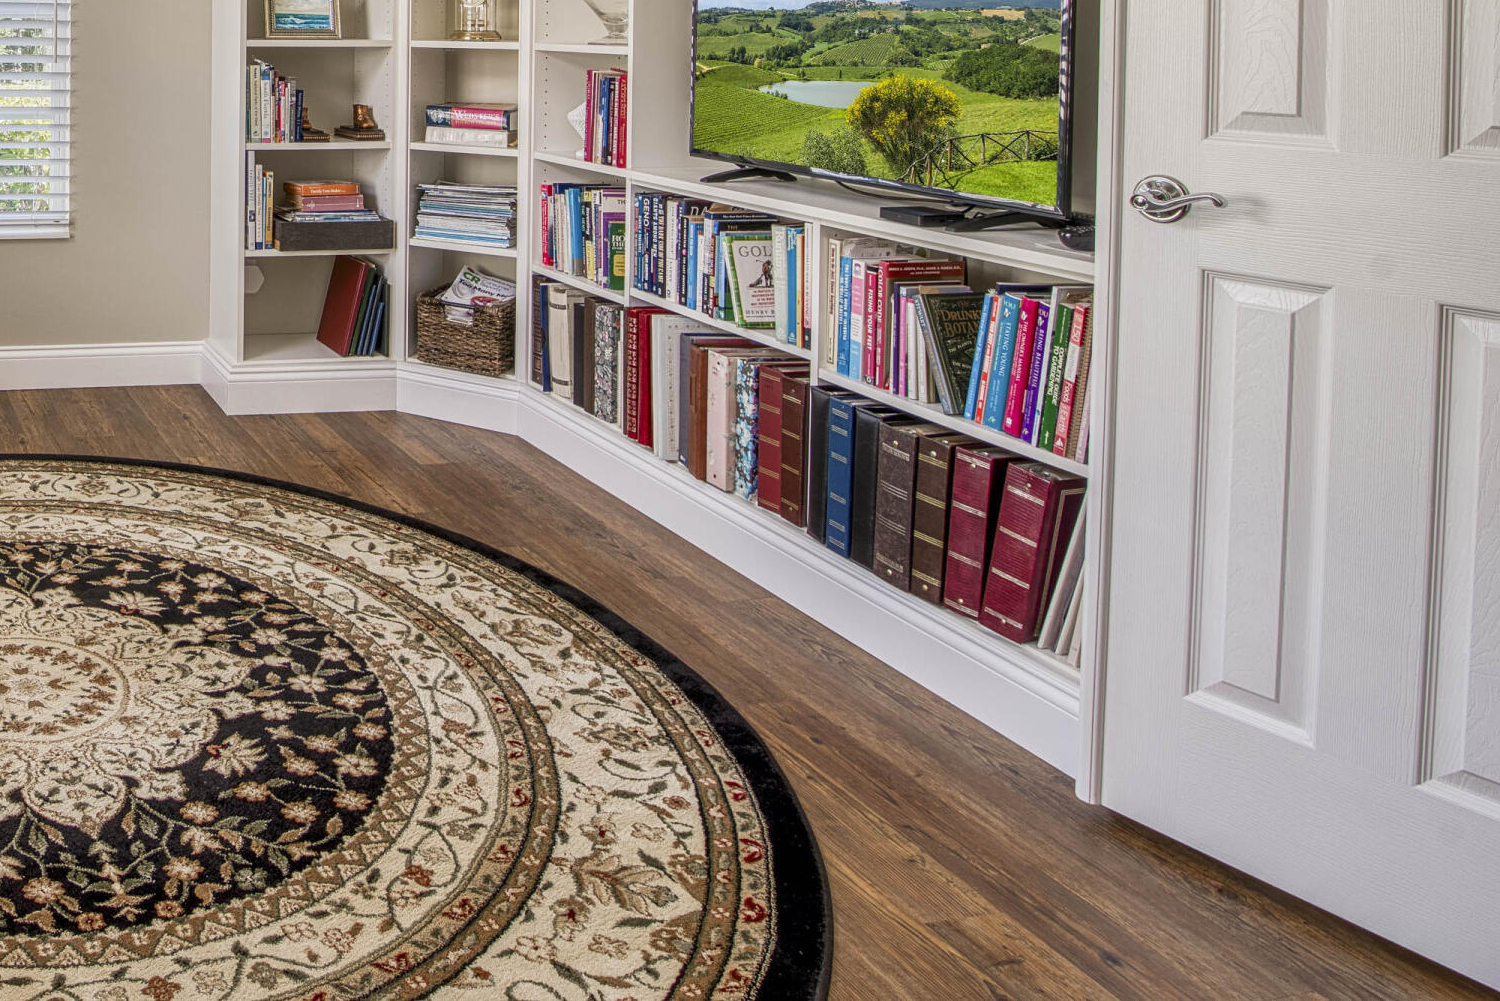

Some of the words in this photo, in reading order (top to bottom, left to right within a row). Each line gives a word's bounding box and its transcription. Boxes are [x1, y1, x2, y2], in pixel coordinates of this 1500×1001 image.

[738, 245, 773, 258] GOL
[459, 279, 473, 289] Too
[473, 286, 495, 297] Many
[463, 271, 481, 284] CR
[940, 309, 981, 321] DRUNK
[943, 321, 978, 337] BOTAN
[1003, 322, 1012, 351] STAYING
[1072, 323, 1081, 343] 150
[1018, 333, 1027, 358] OWNER'S
[1036, 329, 1045, 352] BEING
[1053, 345, 1060, 355] TO
[998, 352, 1009, 377] YOUNG
[1015, 358, 1024, 382] MANUAL
[1031, 352, 1042, 388] BEAUTIFUL
[1054, 346, 1065, 383] COMPLETE
[1046, 356, 1058, 396] GARDENING
[1051, 384, 1060, 406] GUIDE
[1062, 381, 1072, 403] Foods
[1058, 409, 1069, 434] Earth
